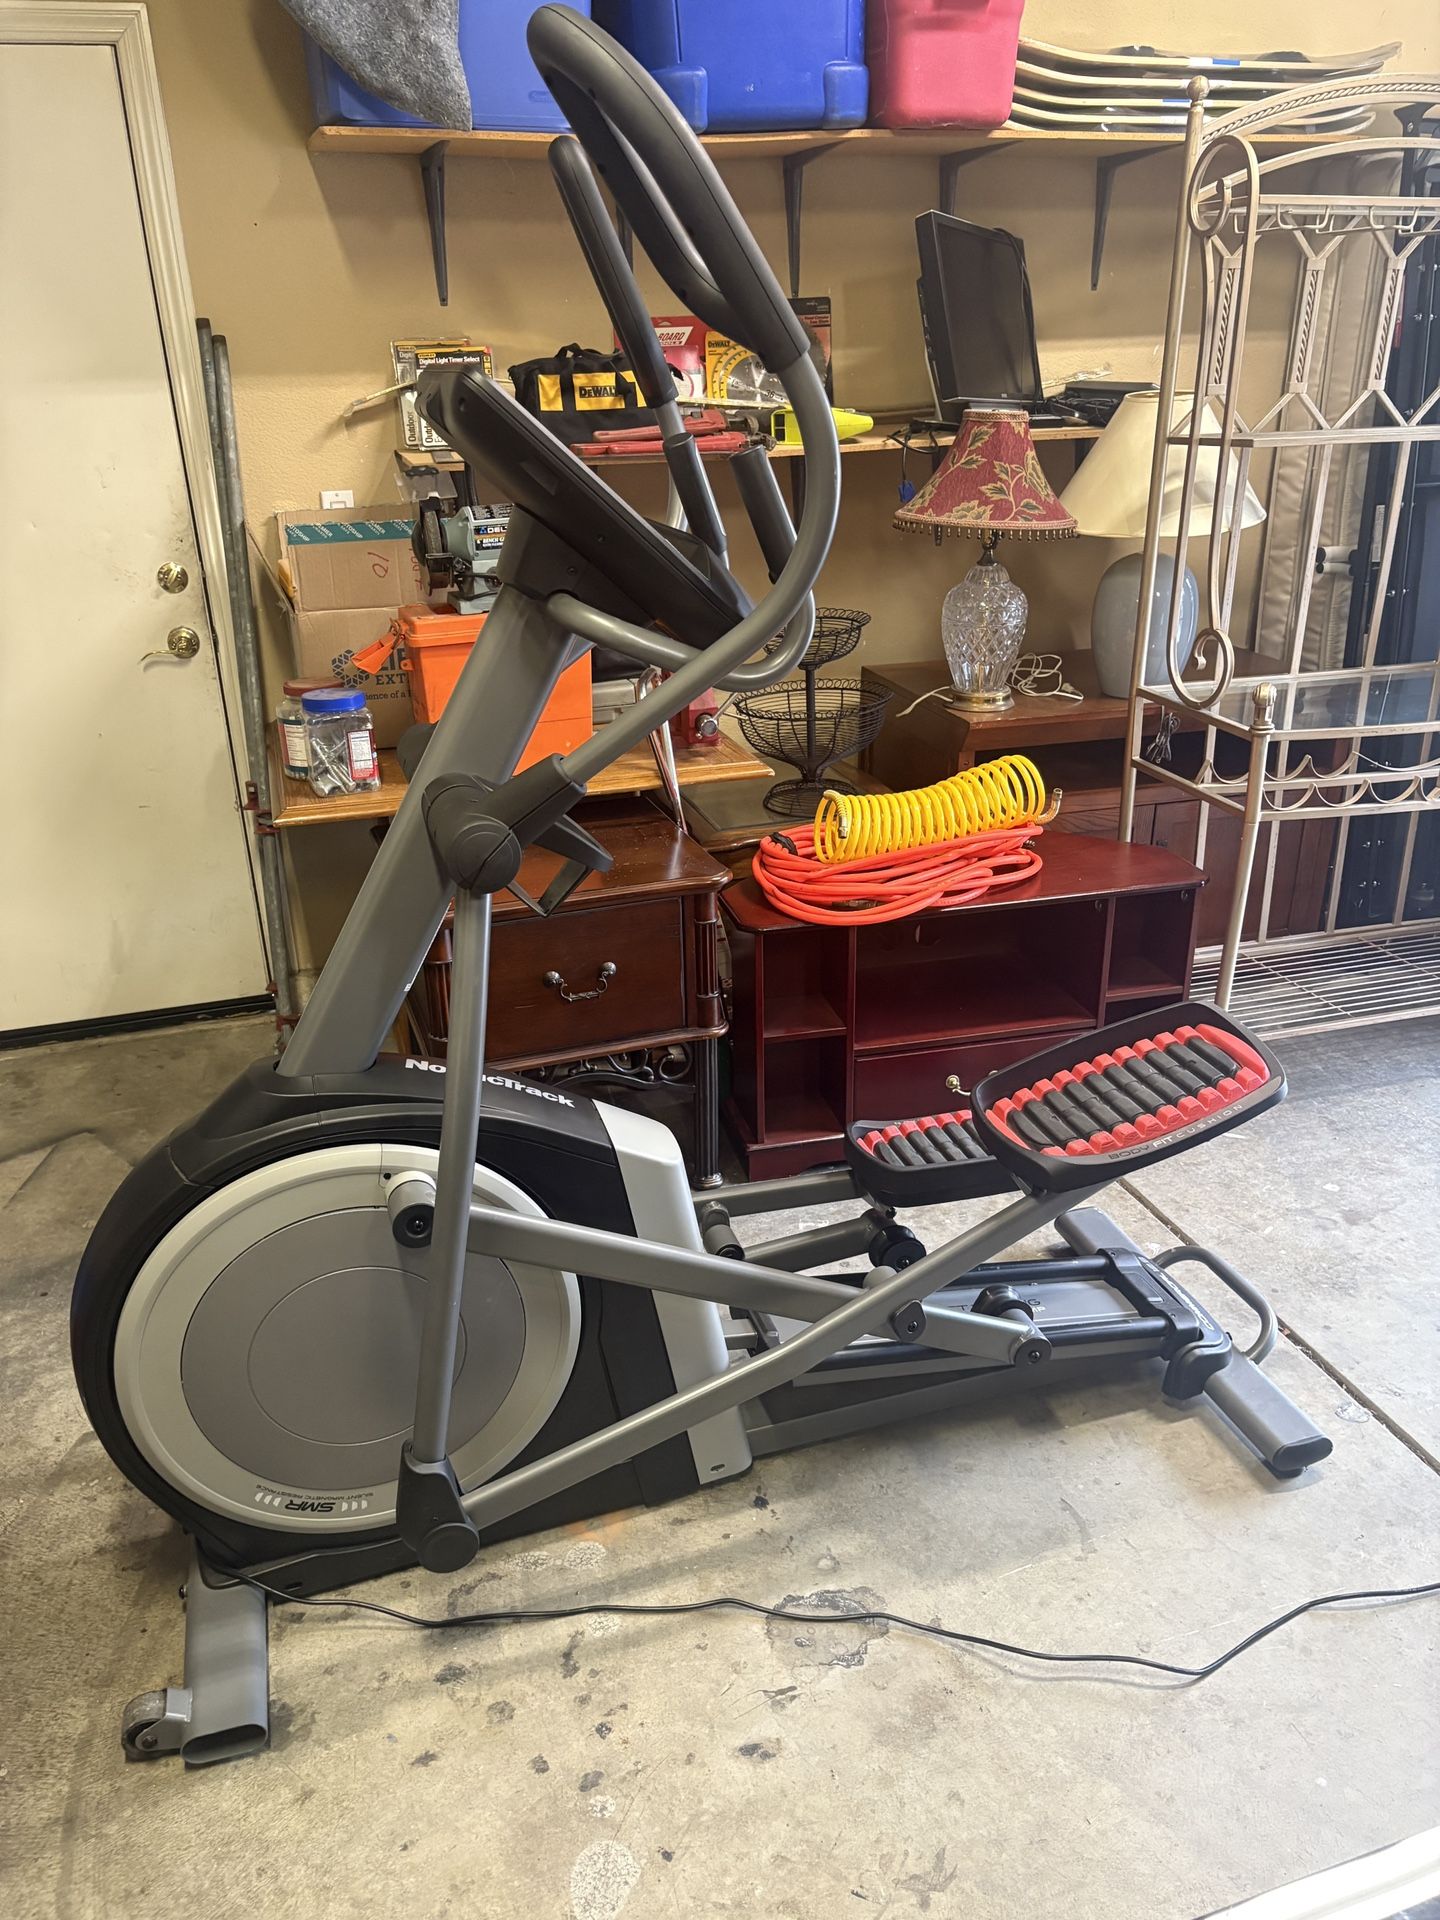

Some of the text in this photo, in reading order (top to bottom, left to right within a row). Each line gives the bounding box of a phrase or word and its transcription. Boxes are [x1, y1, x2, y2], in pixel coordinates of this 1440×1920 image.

[707, 340, 730, 348] DEWALT
[580, 386, 616, 398] DEWAL
[406, 411, 417, 442] Outdoor
[376, 673, 408, 685] EXT
[390, 690, 400, 698] of
[1108, 1104, 1243, 1160] BODY FIT CUSHION
[255, 1483, 303, 1499] RESISTANCE
[284, 1499, 336, 1513] SMR
